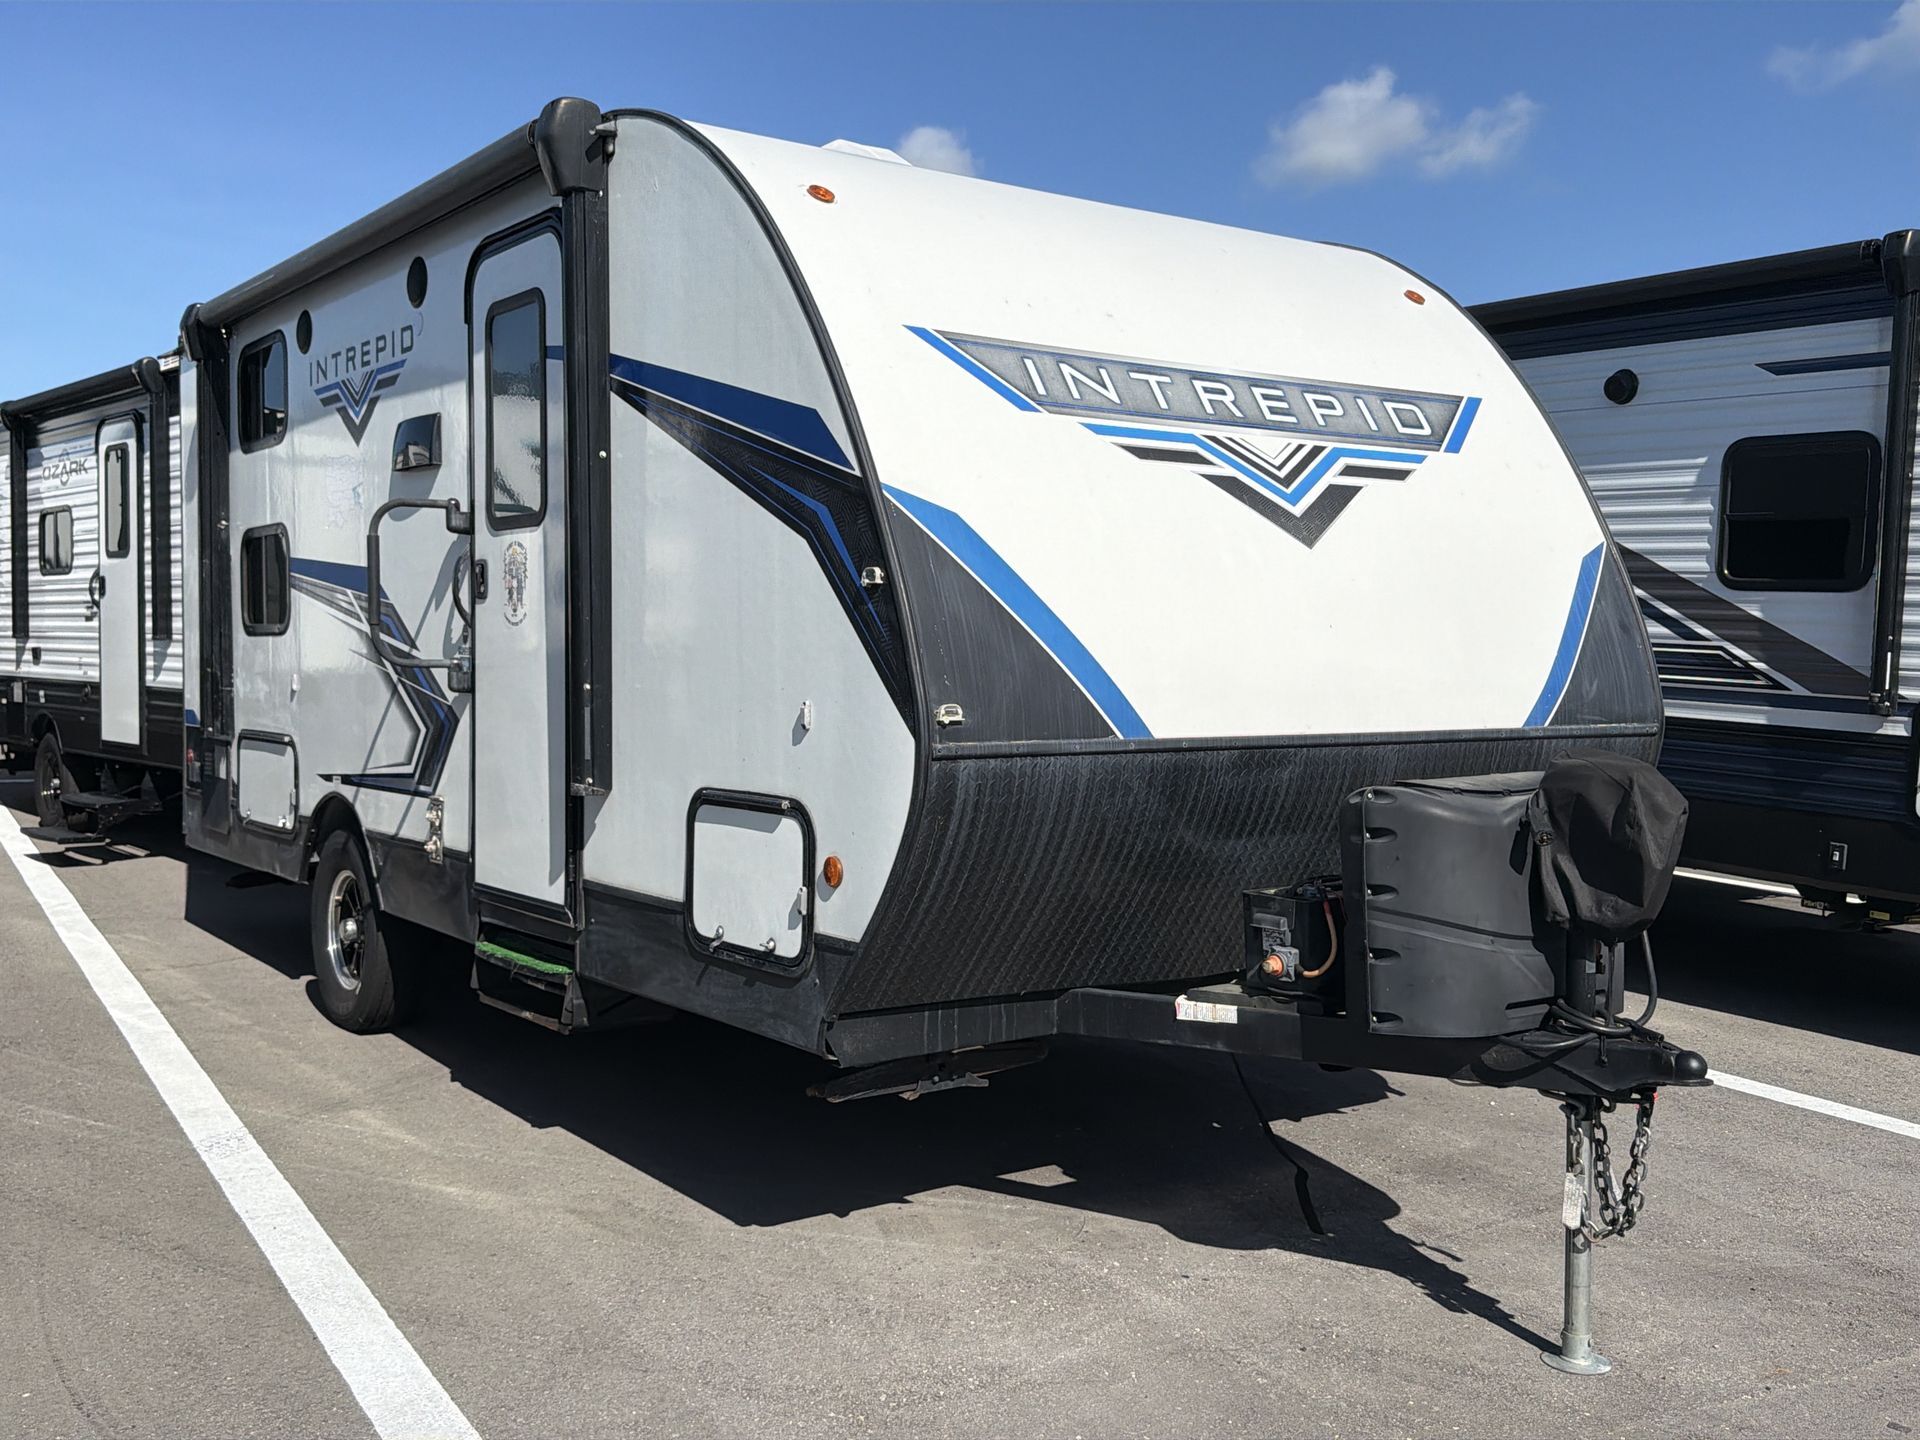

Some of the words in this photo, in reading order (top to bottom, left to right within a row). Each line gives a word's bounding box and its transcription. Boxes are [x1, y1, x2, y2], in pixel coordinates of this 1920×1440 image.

[309, 324, 414, 387] INTREPID
[1022, 357, 1432, 437] INTREPID
[42, 458, 89, 486] OZARK
